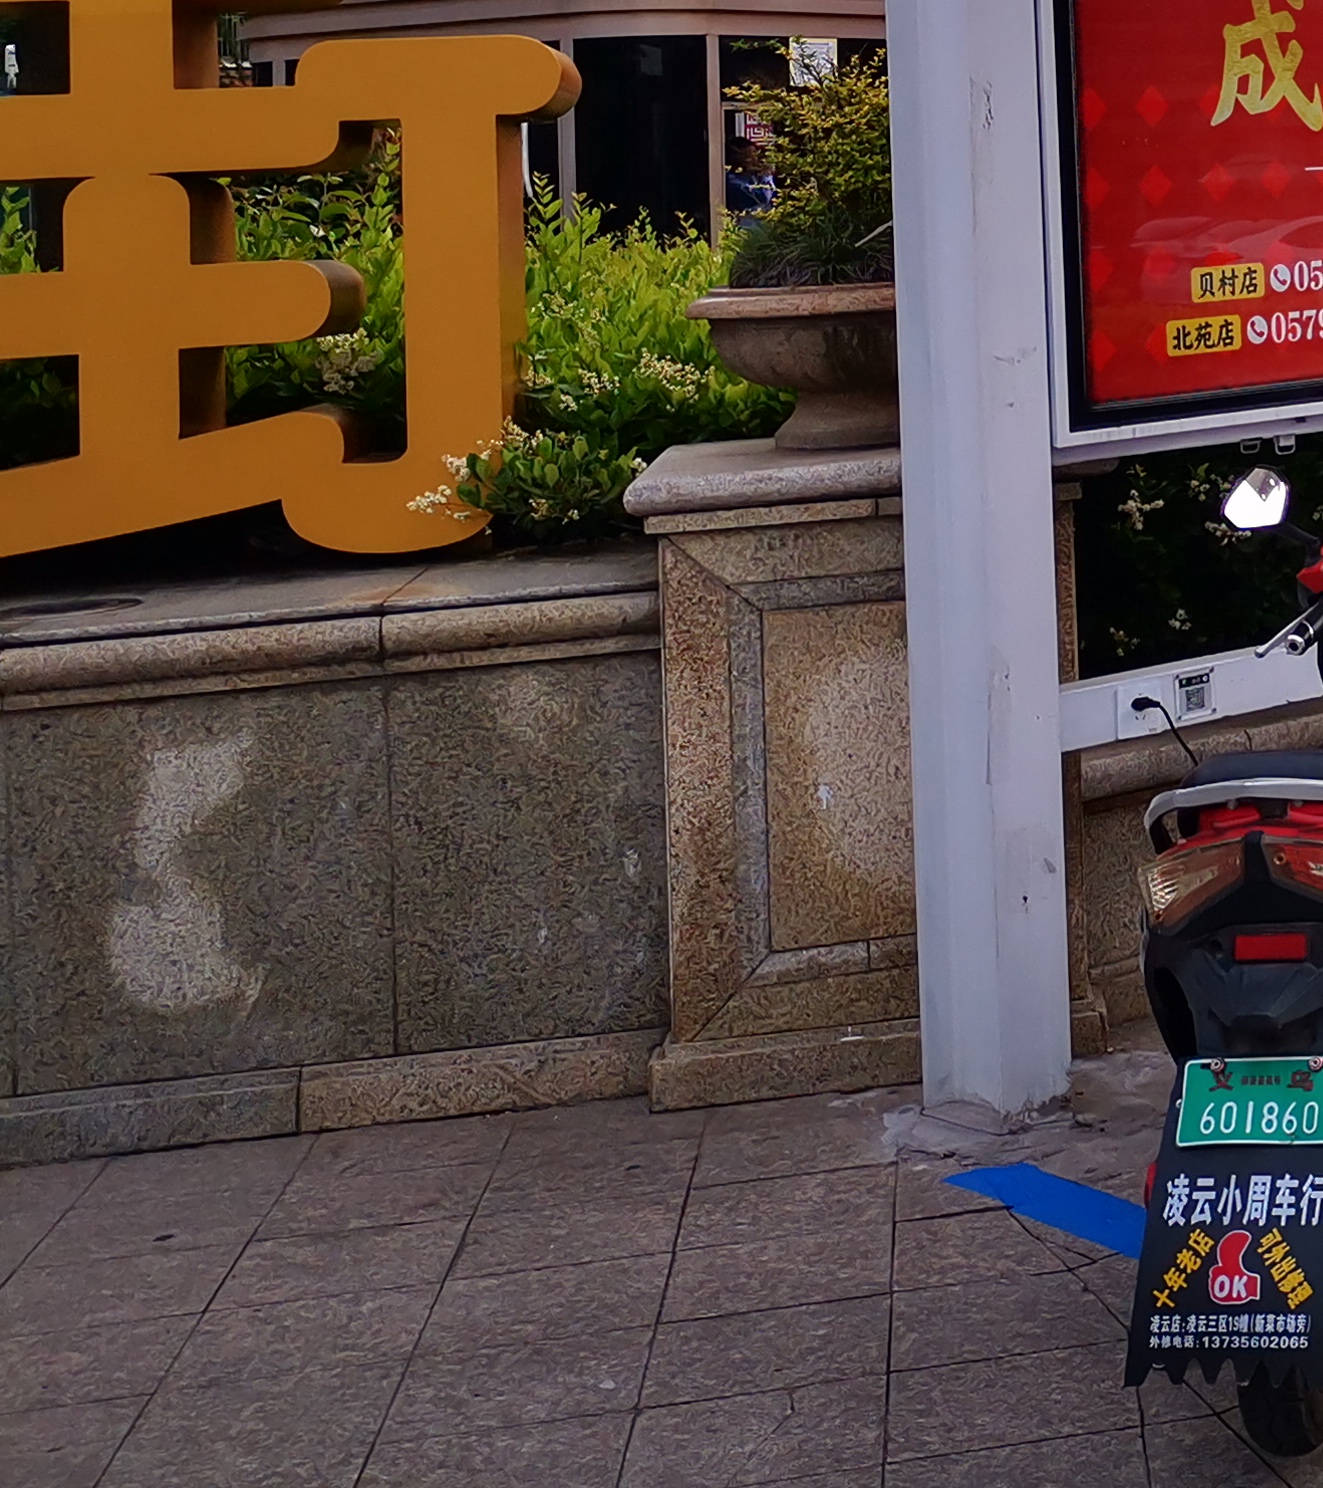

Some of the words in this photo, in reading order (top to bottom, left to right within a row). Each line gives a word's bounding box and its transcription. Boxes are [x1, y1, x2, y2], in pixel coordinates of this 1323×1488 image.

[1198, 269, 1259, 297] 贝村店
[1172, 320, 1236, 351] 北苑店
[1200, 1100, 1320, 1135] 601860
[1152, 1228, 1216, 1309] 十年老店
[1213, 1274, 1250, 1299] OK
